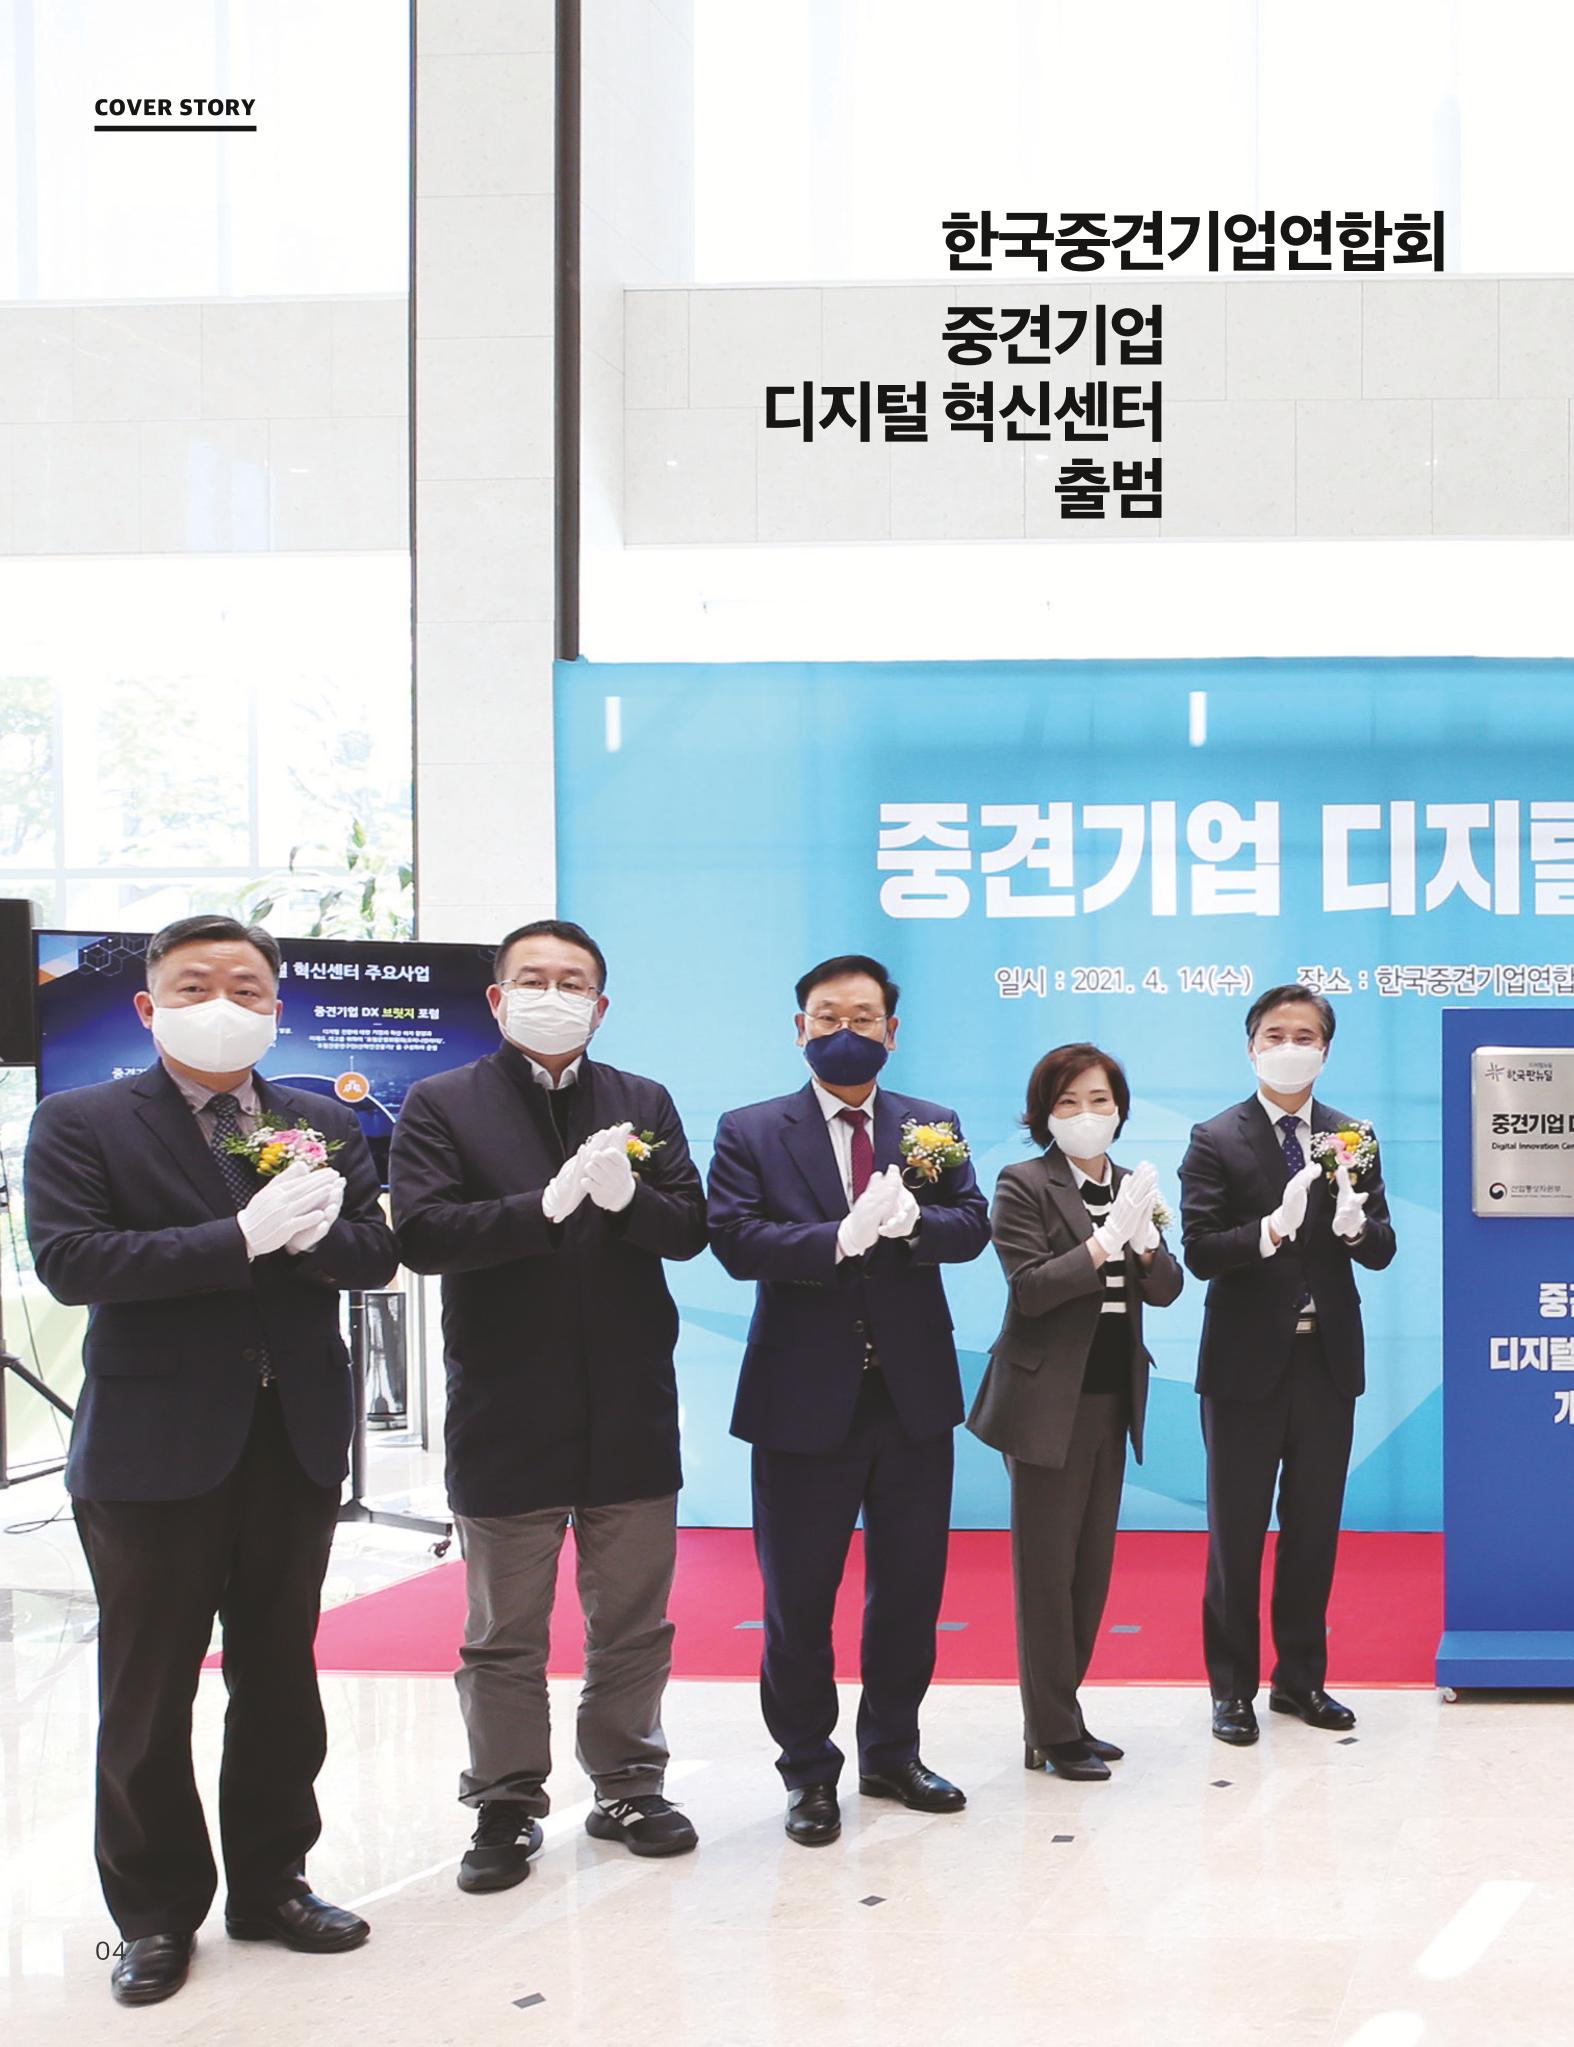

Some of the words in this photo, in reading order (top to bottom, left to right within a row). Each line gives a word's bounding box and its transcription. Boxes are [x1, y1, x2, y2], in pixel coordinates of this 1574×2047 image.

[876, 800, 1281, 919] 중견기업
[293, 961, 360, 981] 혁신센터
[364, 964, 430, 983] 주요사업
[996, 967, 1047, 996] 일시
[1073, 968, 1134, 993] 2021.
[1143, 968, 1168, 993] 4.
[1179, 966, 1252, 996] 14(수)
[1298, 967, 1351, 994] 장소
[314, 1005, 359, 1018] 중견기업
[361, 1007, 380, 1018] DX
[417, 1008, 440, 1020] 포럼
[1492, 1113, 1564, 1135] 중견기업
[1492, 1142, 1517, 1151] Digital
[1519, 1142, 1559, 1150] Innovation
